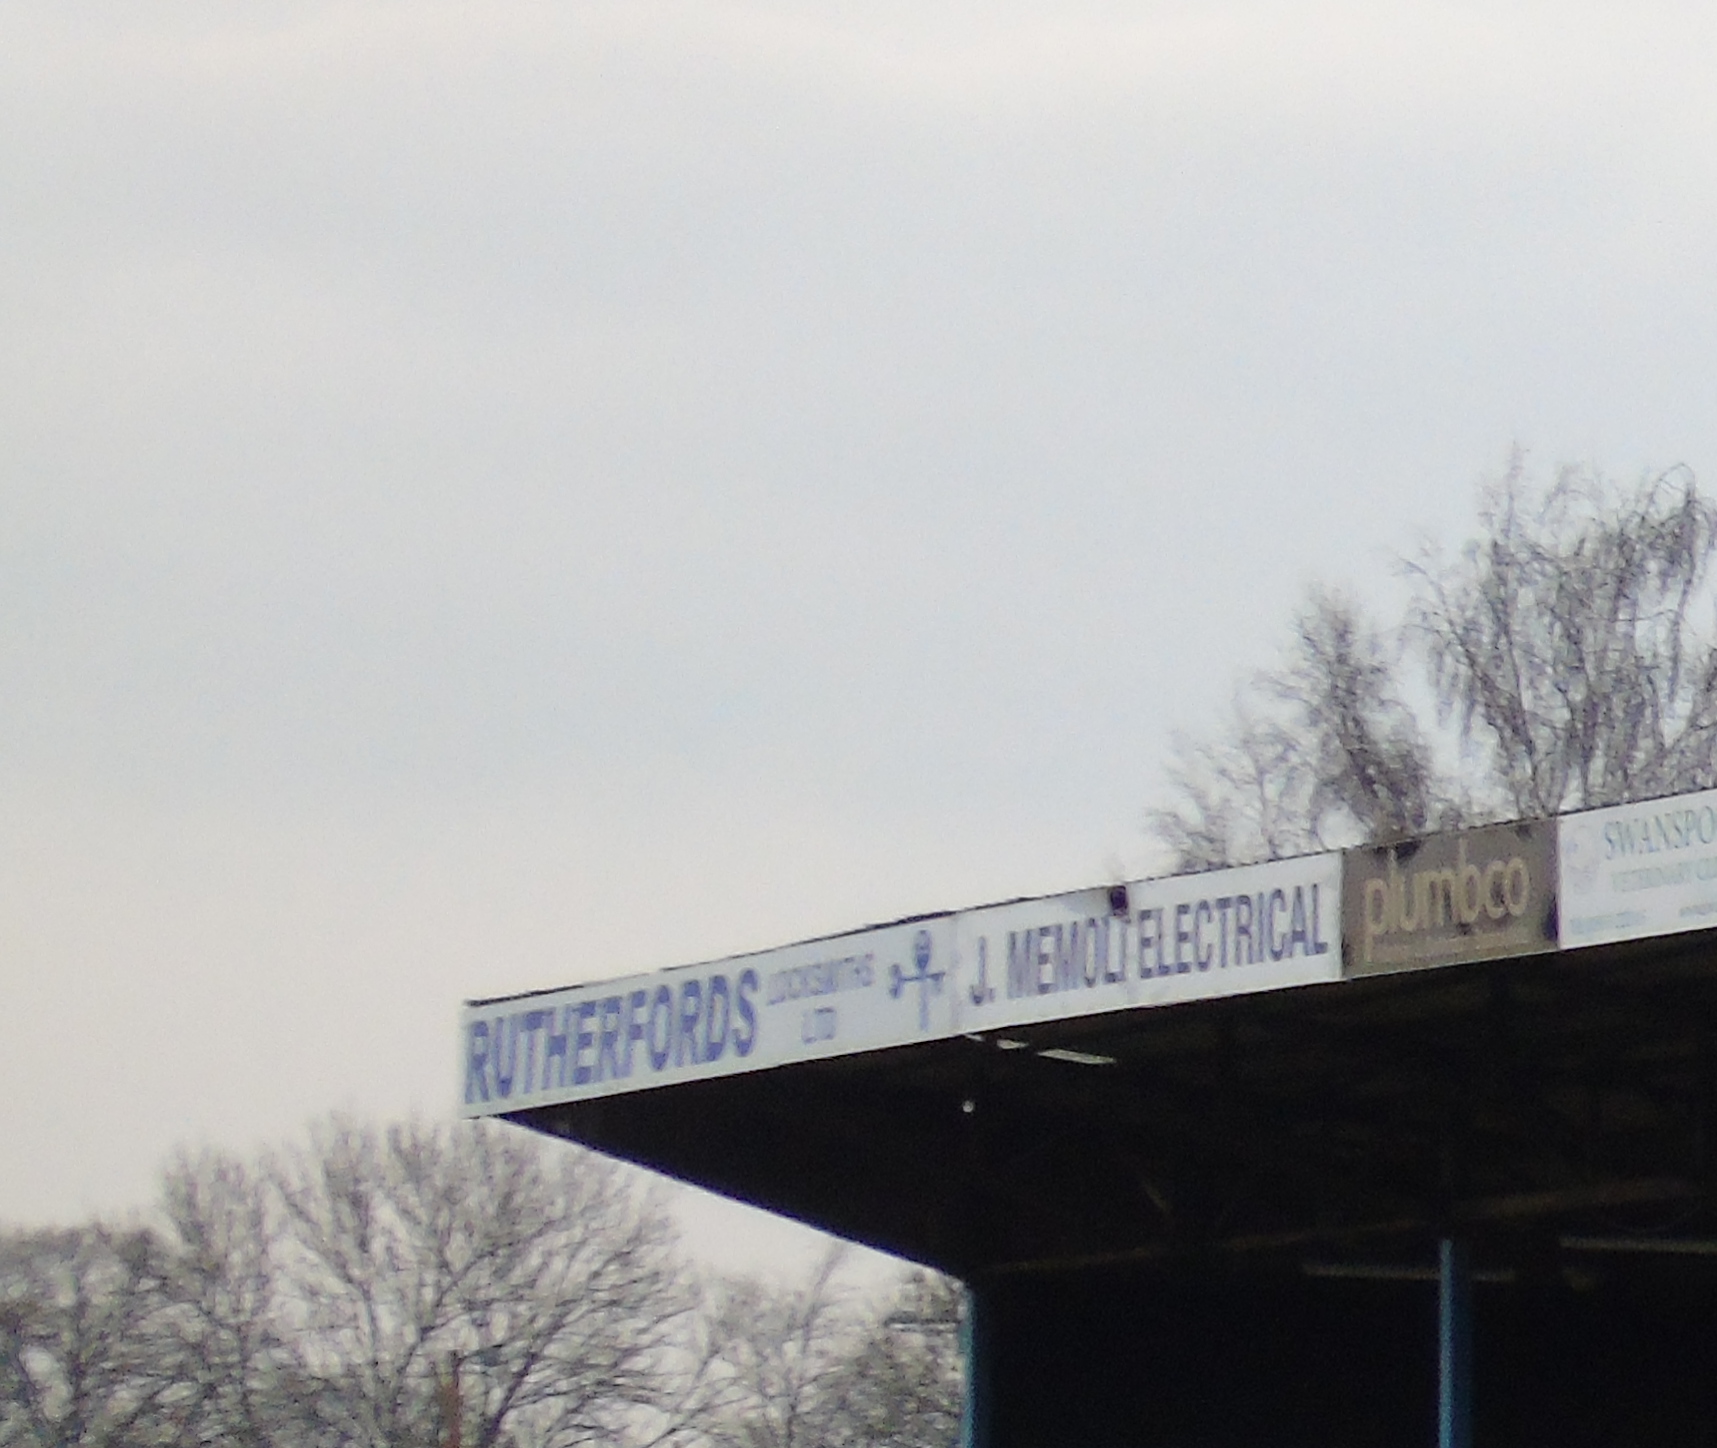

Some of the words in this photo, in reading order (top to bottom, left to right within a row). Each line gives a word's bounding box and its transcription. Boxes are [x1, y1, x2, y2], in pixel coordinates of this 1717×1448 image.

[1006, 915, 1129, 1000] MEMOLI
[1139, 883, 1329, 980] ELECTRICAL
[1365, 837, 1530, 962] plumbco
[465, 968, 759, 1104] RUTHERFORDS
